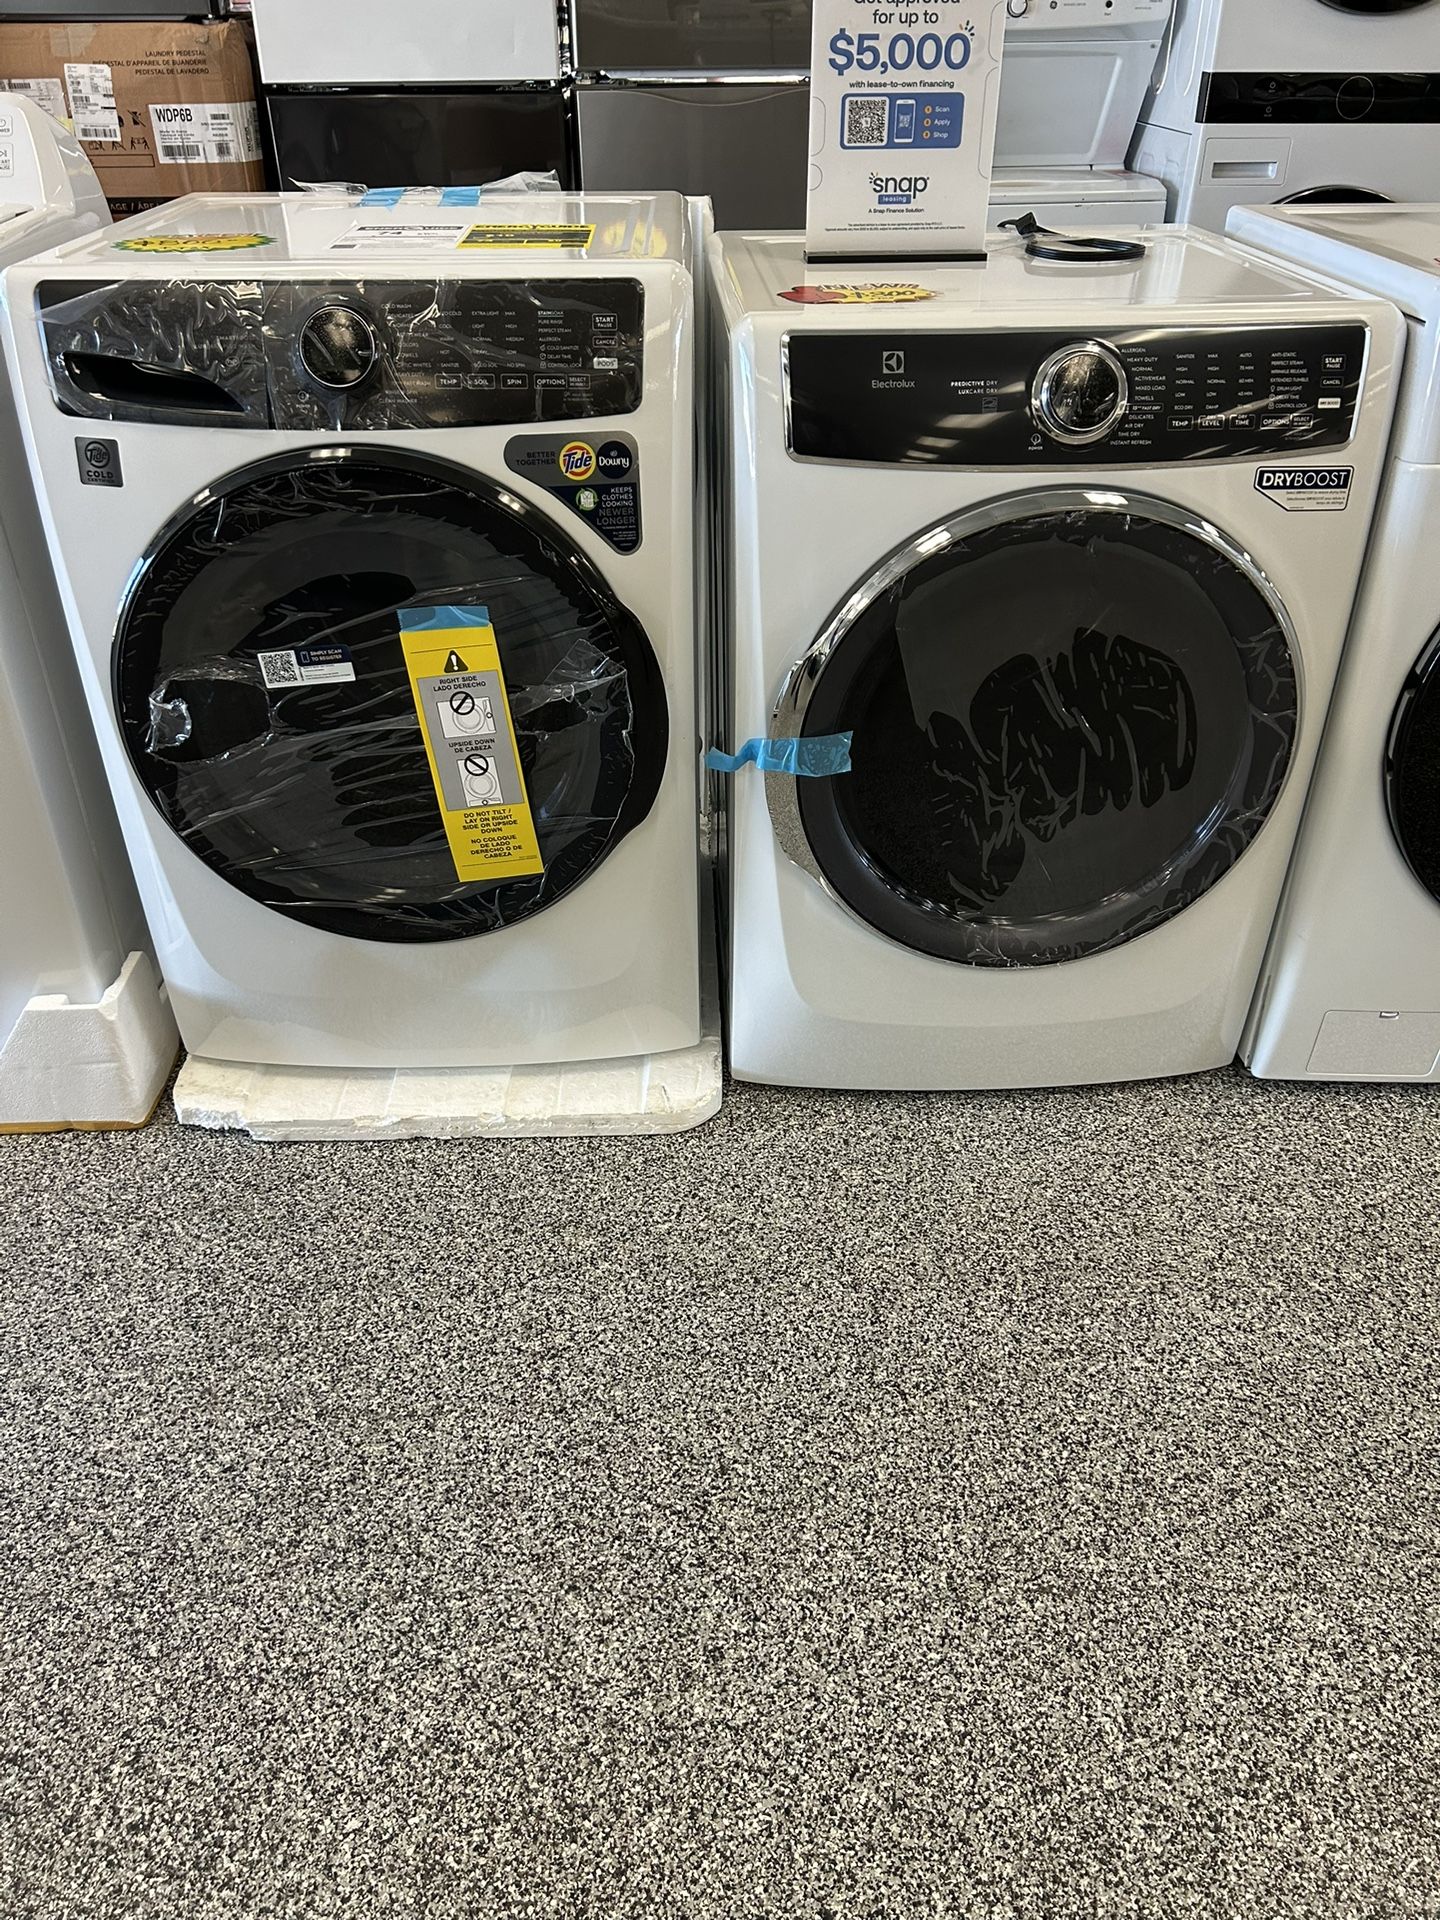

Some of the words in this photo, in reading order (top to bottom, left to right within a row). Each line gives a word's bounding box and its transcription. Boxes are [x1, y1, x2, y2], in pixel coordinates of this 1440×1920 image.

[872, 9, 895, 24] for
[898, 12, 919, 28] up
[923, 10, 939, 24] to
[828, 28, 971, 76] $5,000
[866, 80, 918, 88] lease-to-own
[920, 80, 955, 88] financing
[156, 108, 193, 122] WDP6B
[934, 118, 950, 126] Apply
[933, 131, 949, 139] Shop
[873, 176, 928, 200] snap
[872, 379, 915, 388] Electrolux
[562, 450, 592, 474] Tide
[598, 456, 630, 468] Downy
[86, 470, 114, 478] COLD
[1262, 472, 1348, 486] DRYBOOST
[599, 508, 634, 516] NEWER
[596, 517, 636, 526] LONGER
[454, 681, 486, 690] DERECHO
